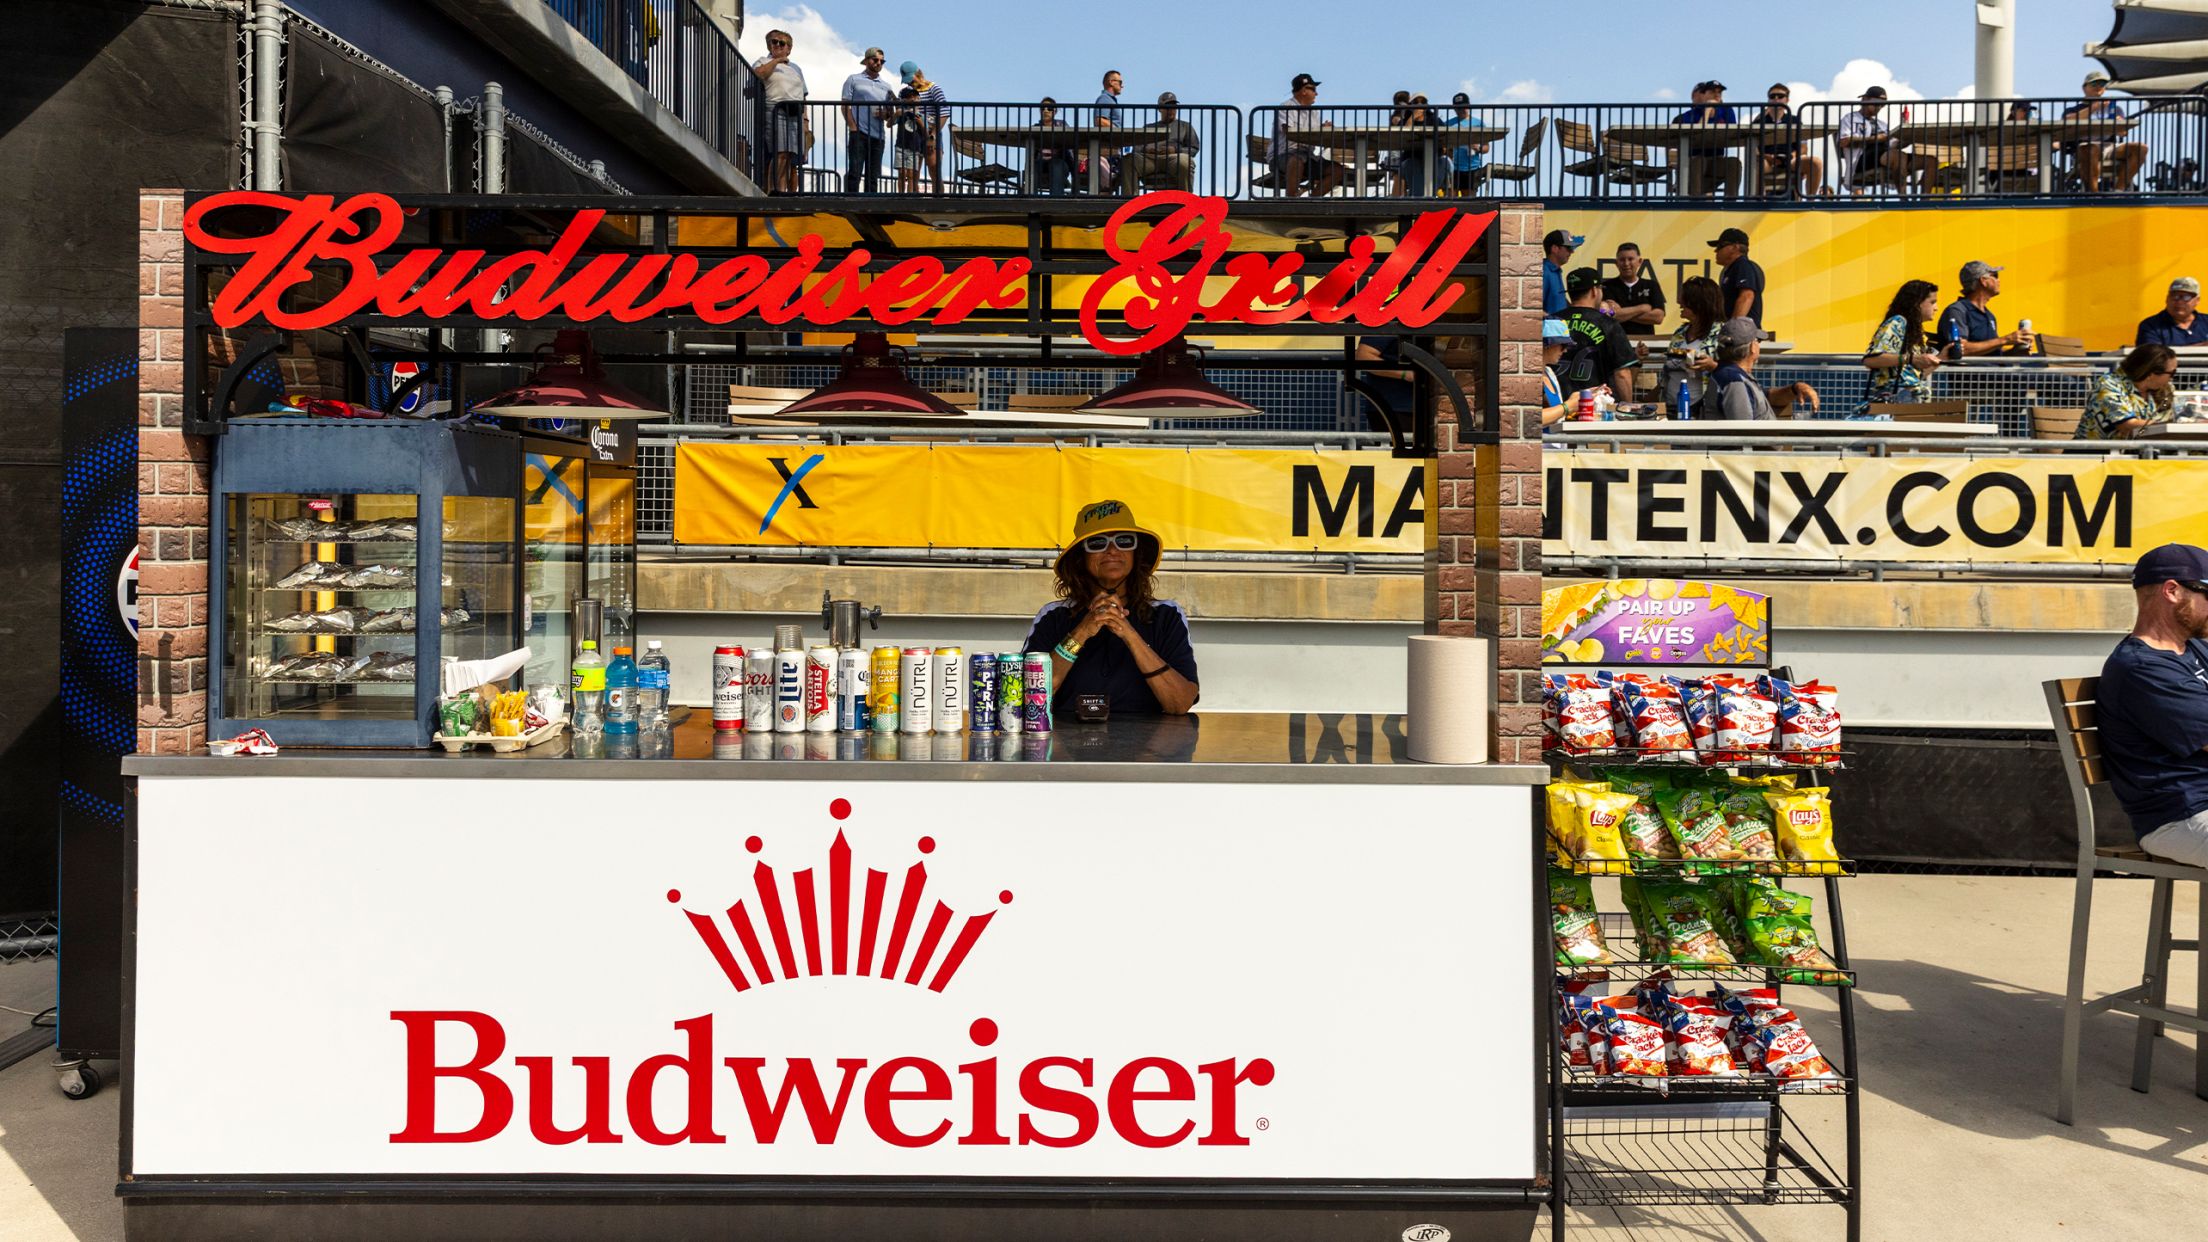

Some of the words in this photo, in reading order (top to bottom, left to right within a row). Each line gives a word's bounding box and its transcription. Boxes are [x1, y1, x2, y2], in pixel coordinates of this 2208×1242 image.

[183, 191, 1032, 330] Budweiser
[1079, 190, 1499, 355] Grill
[591, 425, 619, 449] Corona
[1292, 464, 2133, 549] MATENX.COM
[1618, 600, 1664, 616] PAIR
[1669, 600, 1696, 616] UP
[1618, 626, 1696, 645] FAVES
[1641, 617, 1675, 636] your
[745, 672, 775, 686] oors
[779, 661, 803, 703] Lite
[747, 686, 772, 696] GHT
[814, 669, 823, 710] STELLA
[1804, 723, 1830, 735] Jack
[1725, 795, 1751, 804] ampton
[1792, 808, 1821, 825] Lay's
[1634, 1041, 1656, 1052] ack
[389, 1010, 1276, 1149] Budweiser
